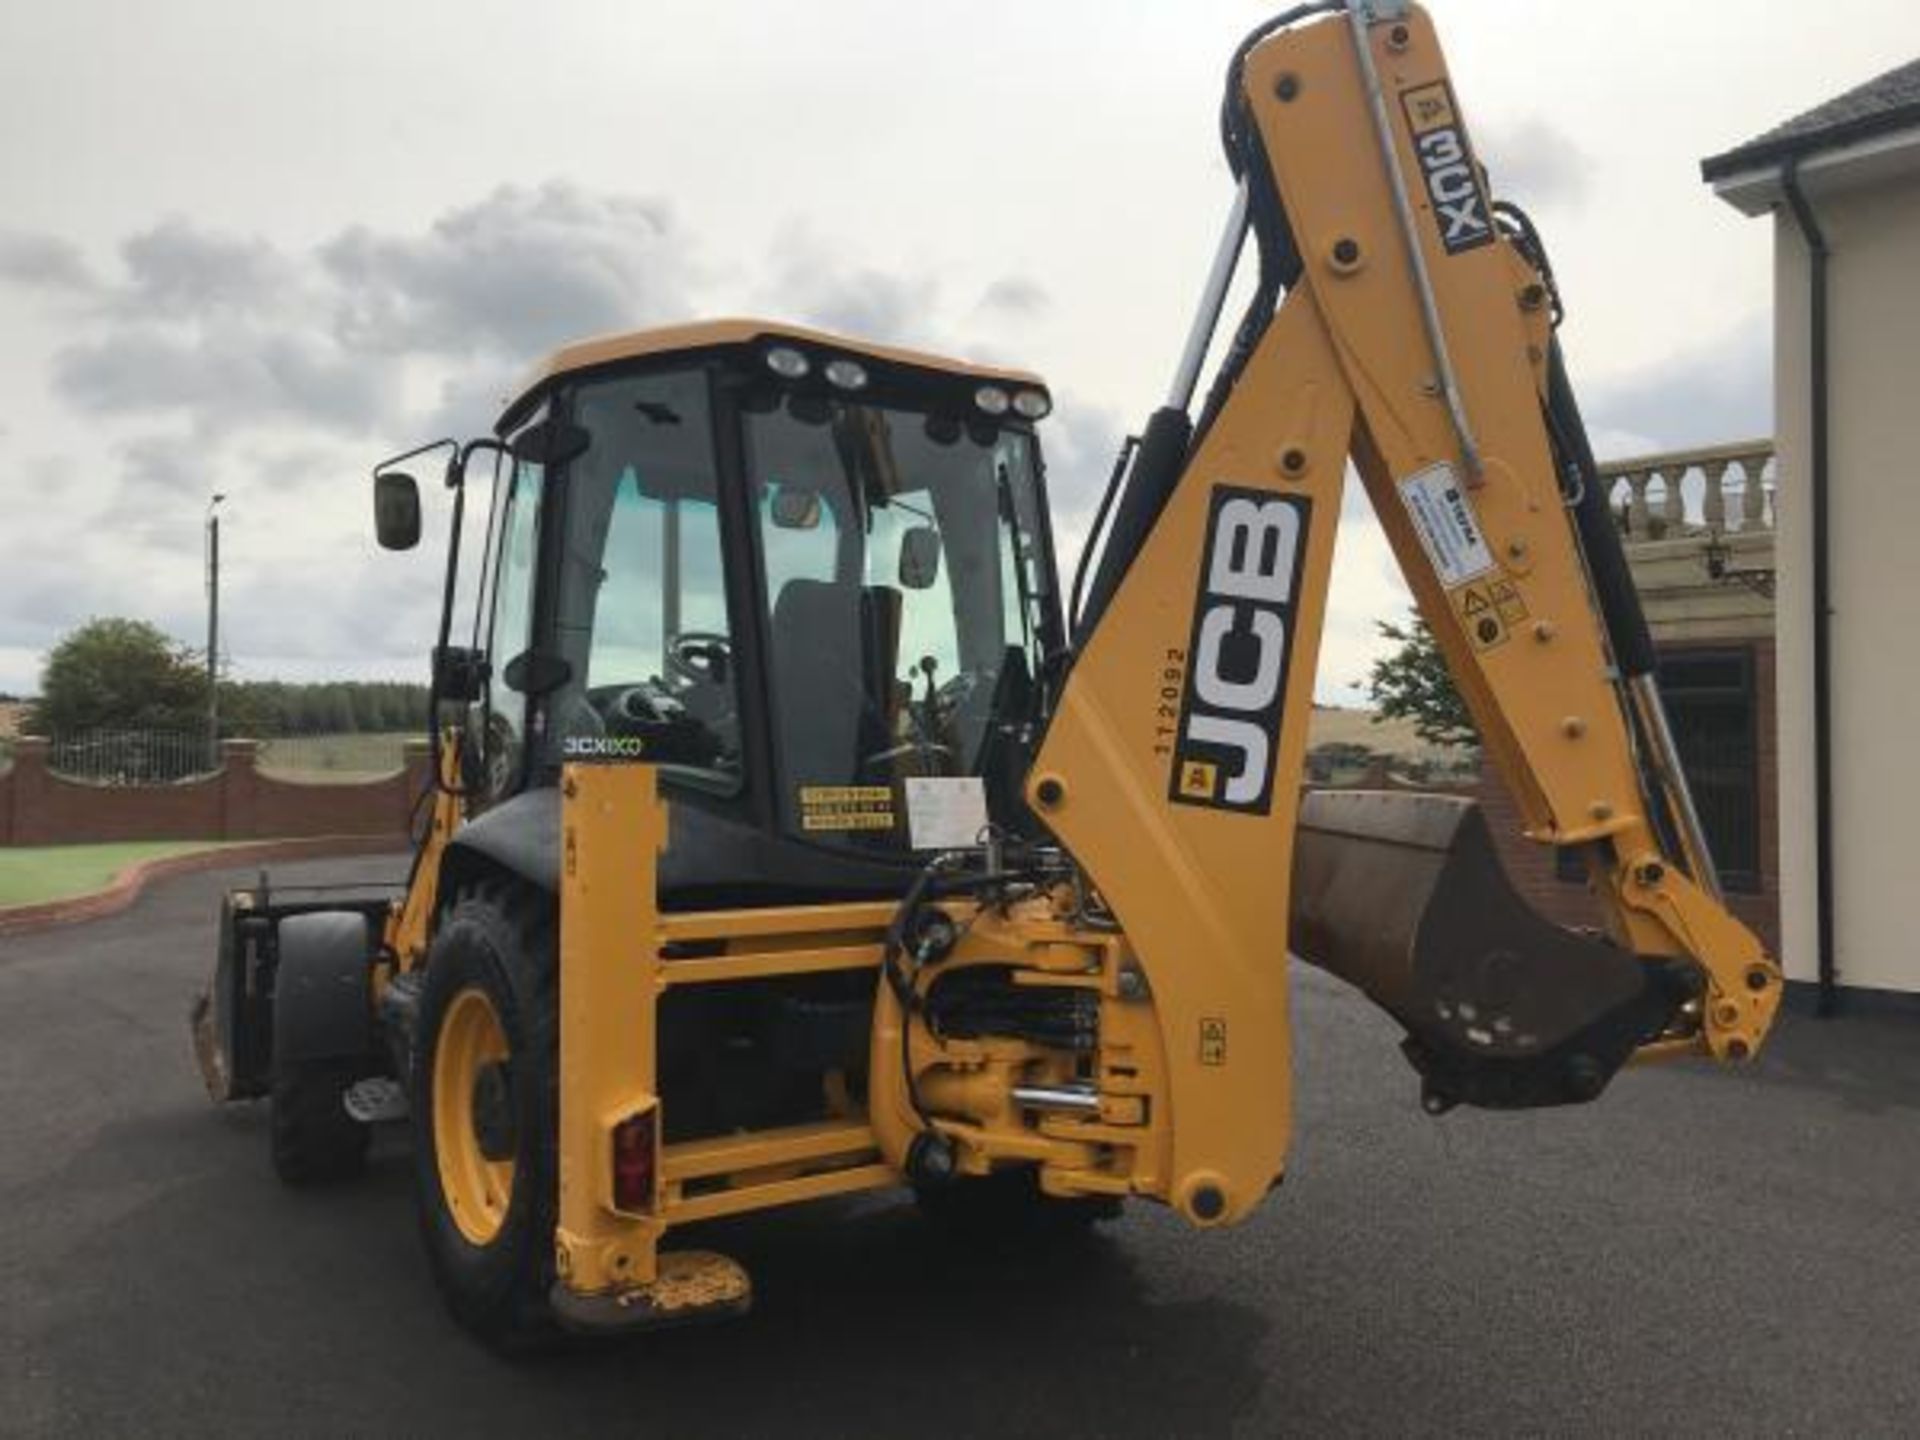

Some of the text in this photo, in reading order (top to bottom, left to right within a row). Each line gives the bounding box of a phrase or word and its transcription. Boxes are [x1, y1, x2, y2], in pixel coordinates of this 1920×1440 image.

[1419, 129, 1489, 239] 3CX
[1153, 648, 1185, 757] 112092
[1187, 499, 1300, 804] JCB
